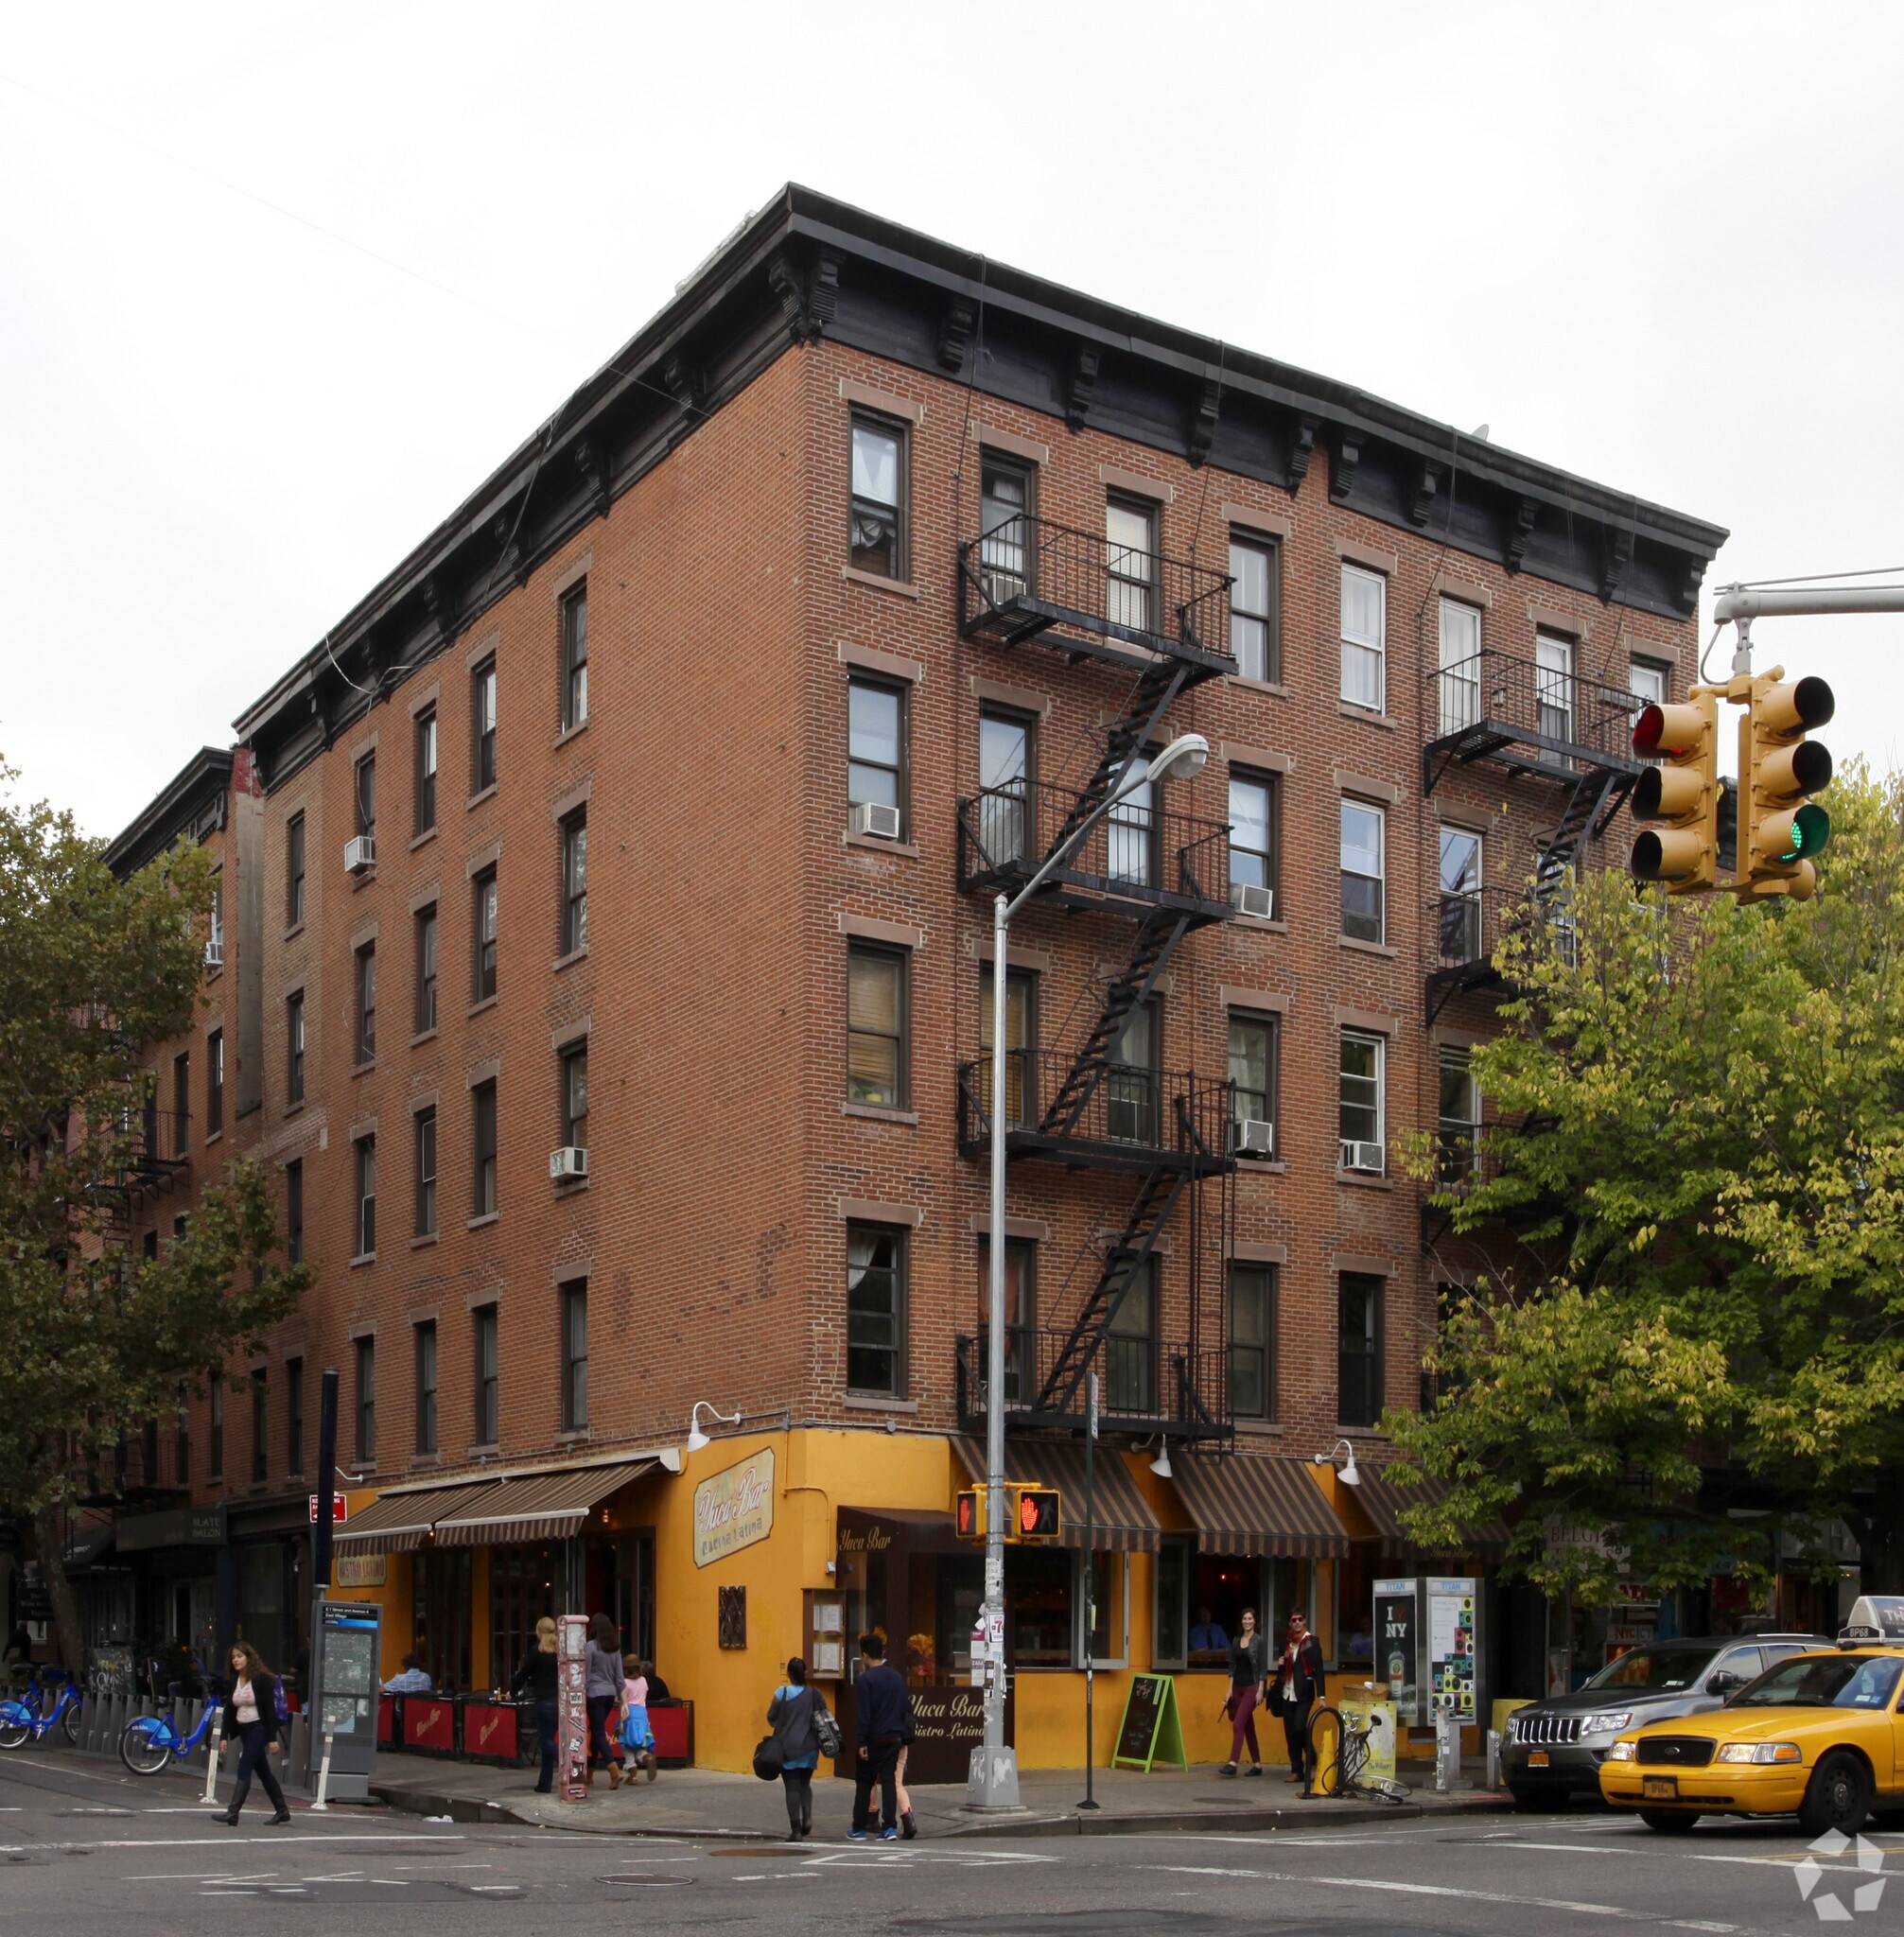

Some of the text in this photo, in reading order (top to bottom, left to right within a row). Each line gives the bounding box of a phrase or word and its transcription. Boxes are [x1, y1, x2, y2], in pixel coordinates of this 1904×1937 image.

[698, 1467, 770, 1535] Yuca Bar
[192, 1517, 220, 1527] SLATE
[191, 1528, 221, 1538] SALON
[839, 1527, 892, 1551] Yuca Bar
[1551, 1527, 1608, 1543] BELGI
[340, 1561, 360, 1579] BISTRO
[1386, 1582, 1406, 1591] TITAN
[1441, 1581, 1461, 1591] TITAN
[1387, 1606, 1393, 1621] I
[1386, 1623, 1406, 1637] NY
[1616, 1626, 1635, 1640] NYC
[1849, 1628, 1869, 1637] 8P68
[908, 1693, 985, 1718] Yuca Bar
[947, 1721, 984, 1739] Latino
